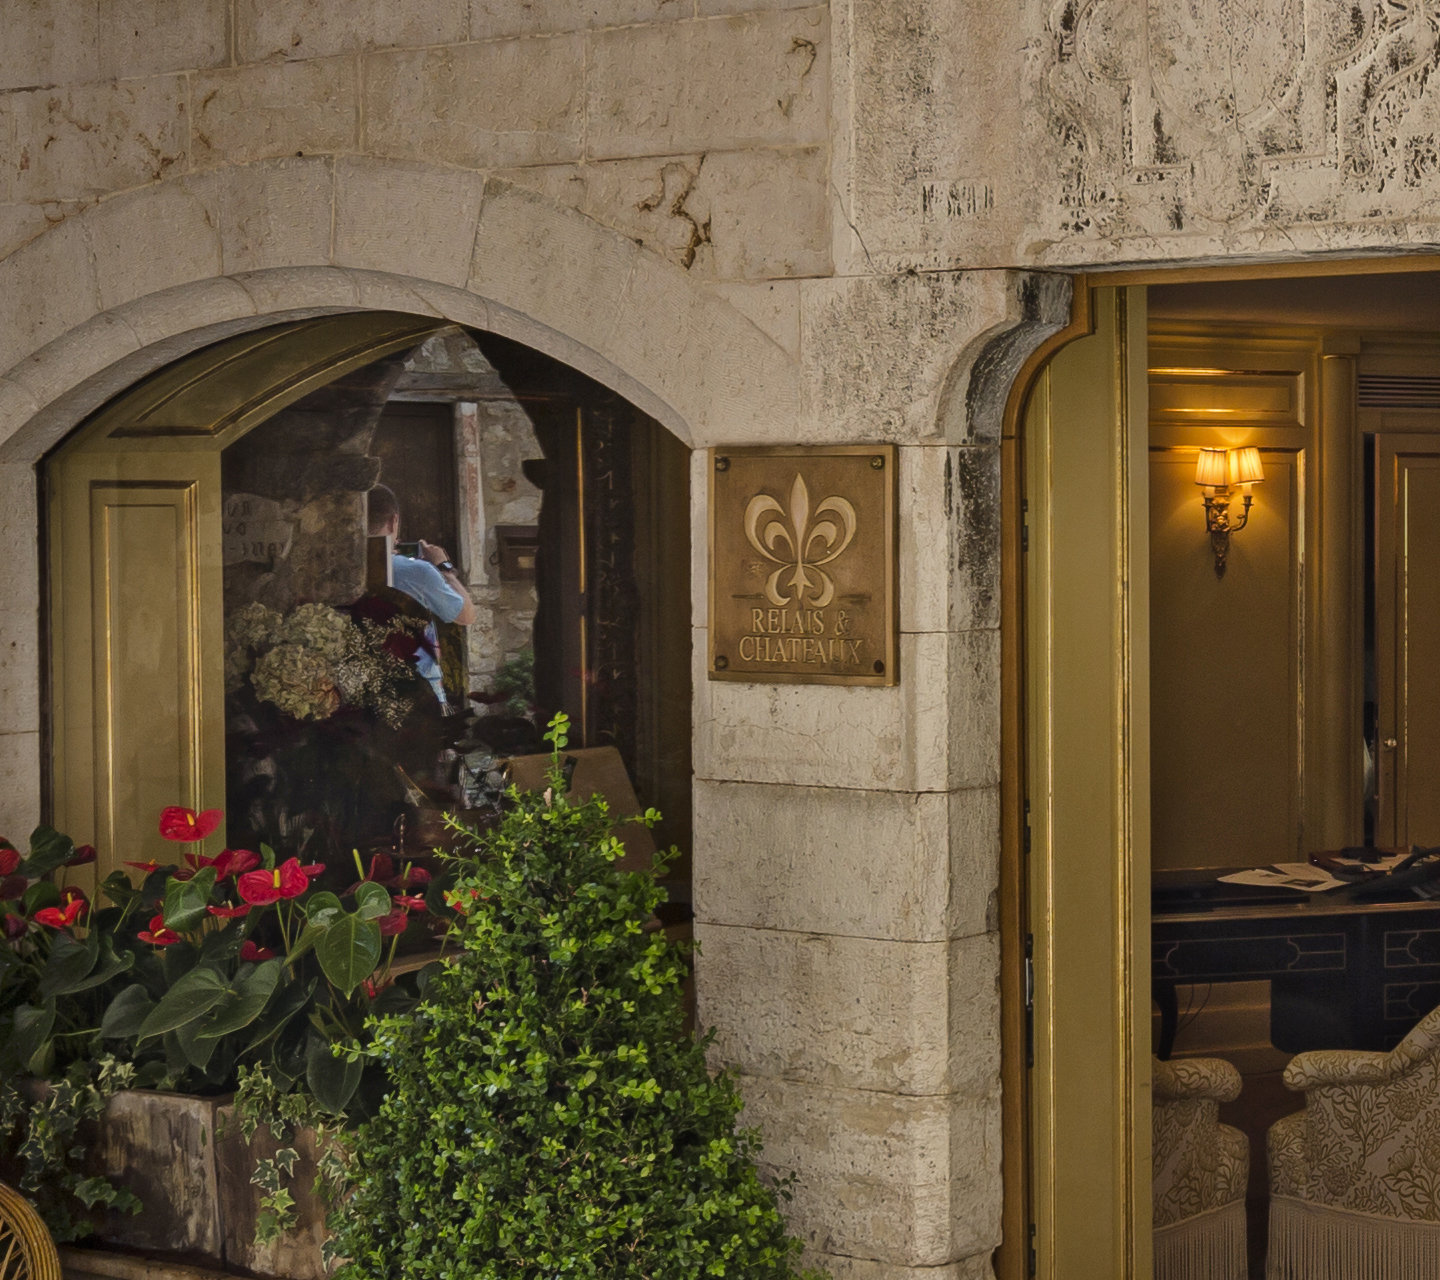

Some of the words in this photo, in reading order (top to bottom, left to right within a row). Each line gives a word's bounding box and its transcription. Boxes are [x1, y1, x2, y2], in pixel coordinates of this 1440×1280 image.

[751, 608, 825, 636] RELAIS
[833, 610, 849, 636] &
[738, 635, 863, 664] CHATEAUX
